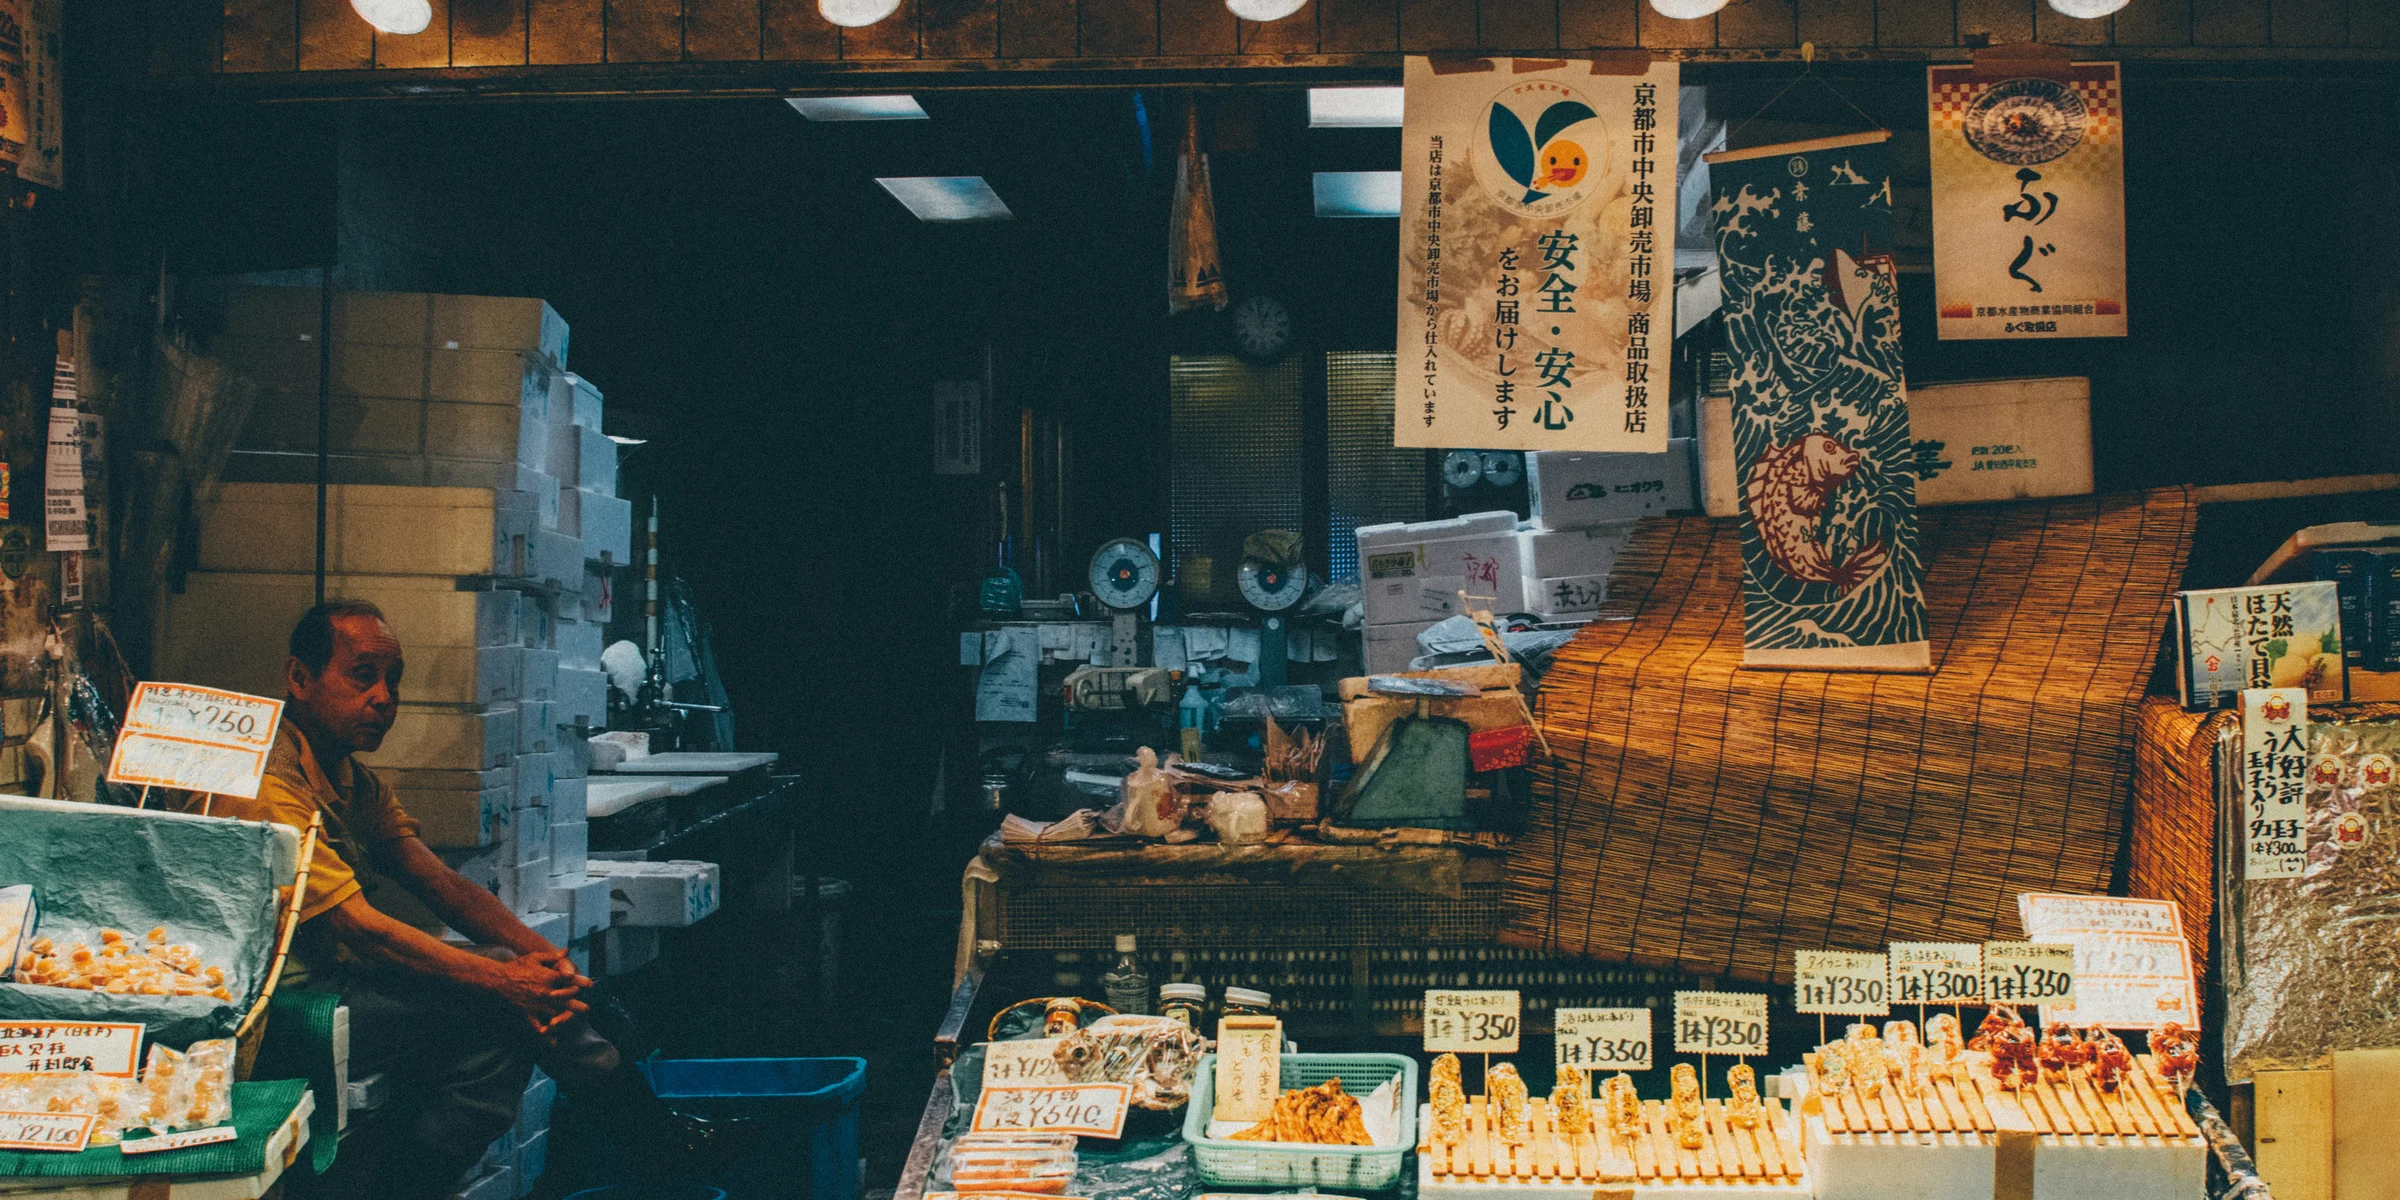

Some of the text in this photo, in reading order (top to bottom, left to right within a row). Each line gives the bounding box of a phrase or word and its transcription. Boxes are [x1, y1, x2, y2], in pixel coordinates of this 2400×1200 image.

[1421, 135, 1443, 428] 当店は京都市中央卸売市場から仕入れています
[1624, 82, 1656, 434] 京都市中央卸売市場 商品取扱店
[2003, 168, 2059, 293] ふぐ
[1492, 248, 1520, 431] をお届けします
[1532, 229, 1580, 431] 安全・安心
[2004, 321, 2057, 333] ふぐ取扱店
[2268, 591, 2294, 637] 天然
[2264, 731, 2282, 798] うずら
[2278, 724, 2306, 804] 大好評
